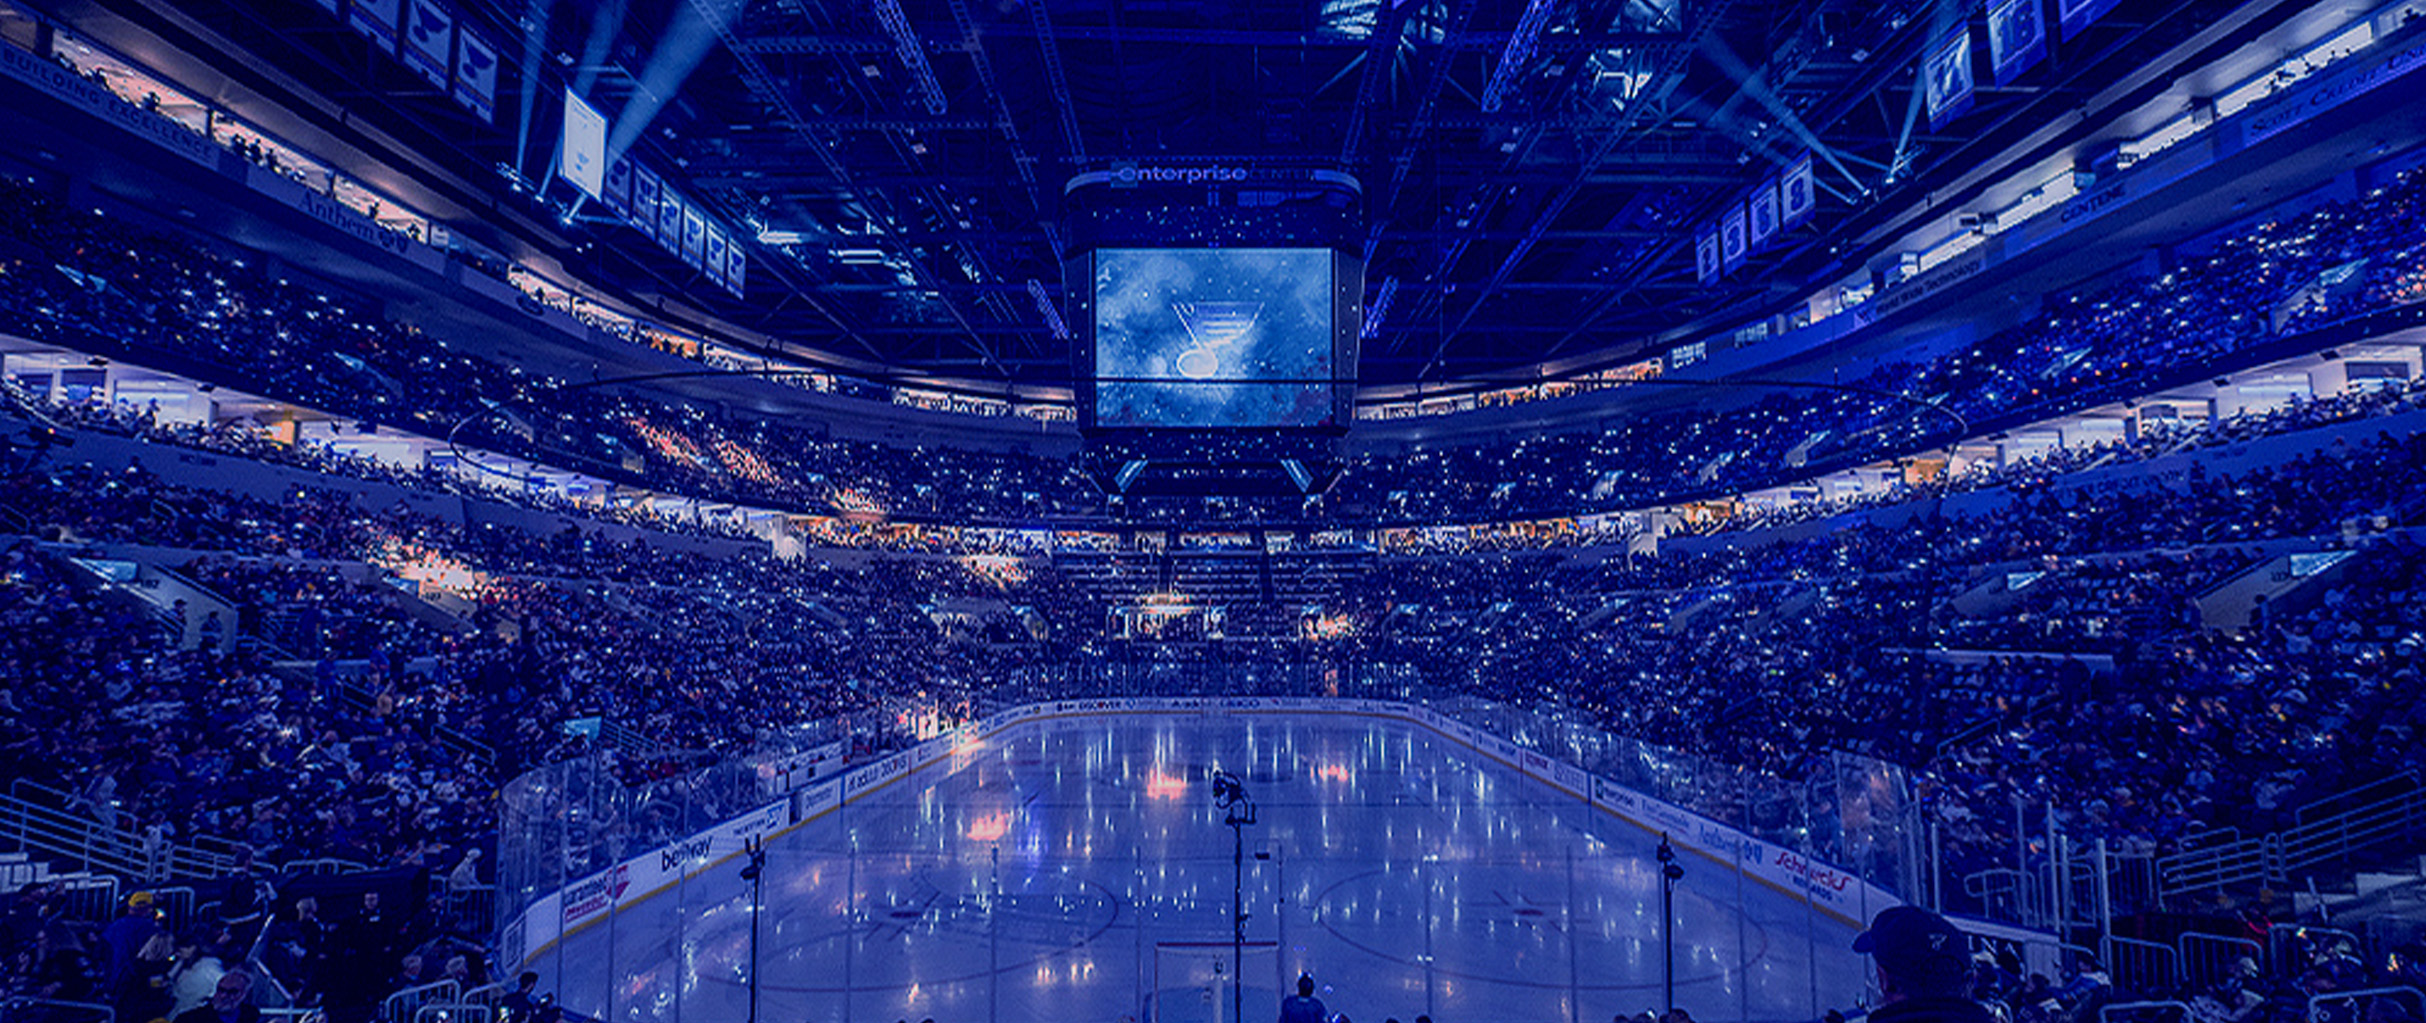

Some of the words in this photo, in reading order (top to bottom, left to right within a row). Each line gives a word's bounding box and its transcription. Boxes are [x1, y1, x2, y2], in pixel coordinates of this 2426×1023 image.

[3, 47, 101, 104] BUILDING
[107, 97, 213, 158] EXCELLENCE
[2251, 104, 2303, 134] SCOTT
[2311, 70, 2376, 106] CREDIT
[1112, 162, 1247, 185] enterprise
[299, 189, 375, 241] Anthem
[2060, 183, 2127, 224] CENTENE
[1925, 258, 1983, 293] Technology
